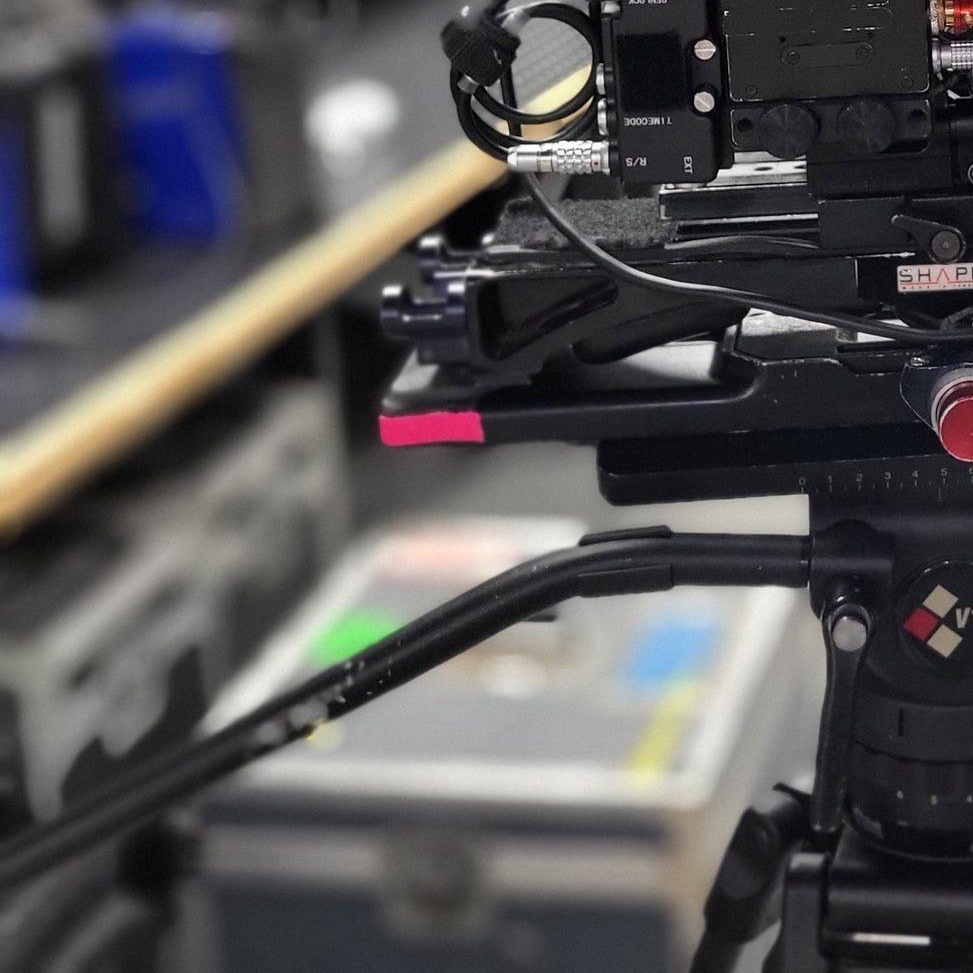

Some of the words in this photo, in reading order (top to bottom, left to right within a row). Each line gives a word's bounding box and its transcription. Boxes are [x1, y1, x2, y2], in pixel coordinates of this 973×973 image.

[623, 115, 672, 127] TIMECODE
[625, 157, 647, 167] R/S
[683, 155, 693, 175] EXT
[798, 477, 807, 486] 0
[828, 475, 833, 483] 1
[856, 473, 863, 482] 2
[884, 471, 892, 480] 3
[912, 470, 920, 479] 4
[940, 468, 948, 477] 5
